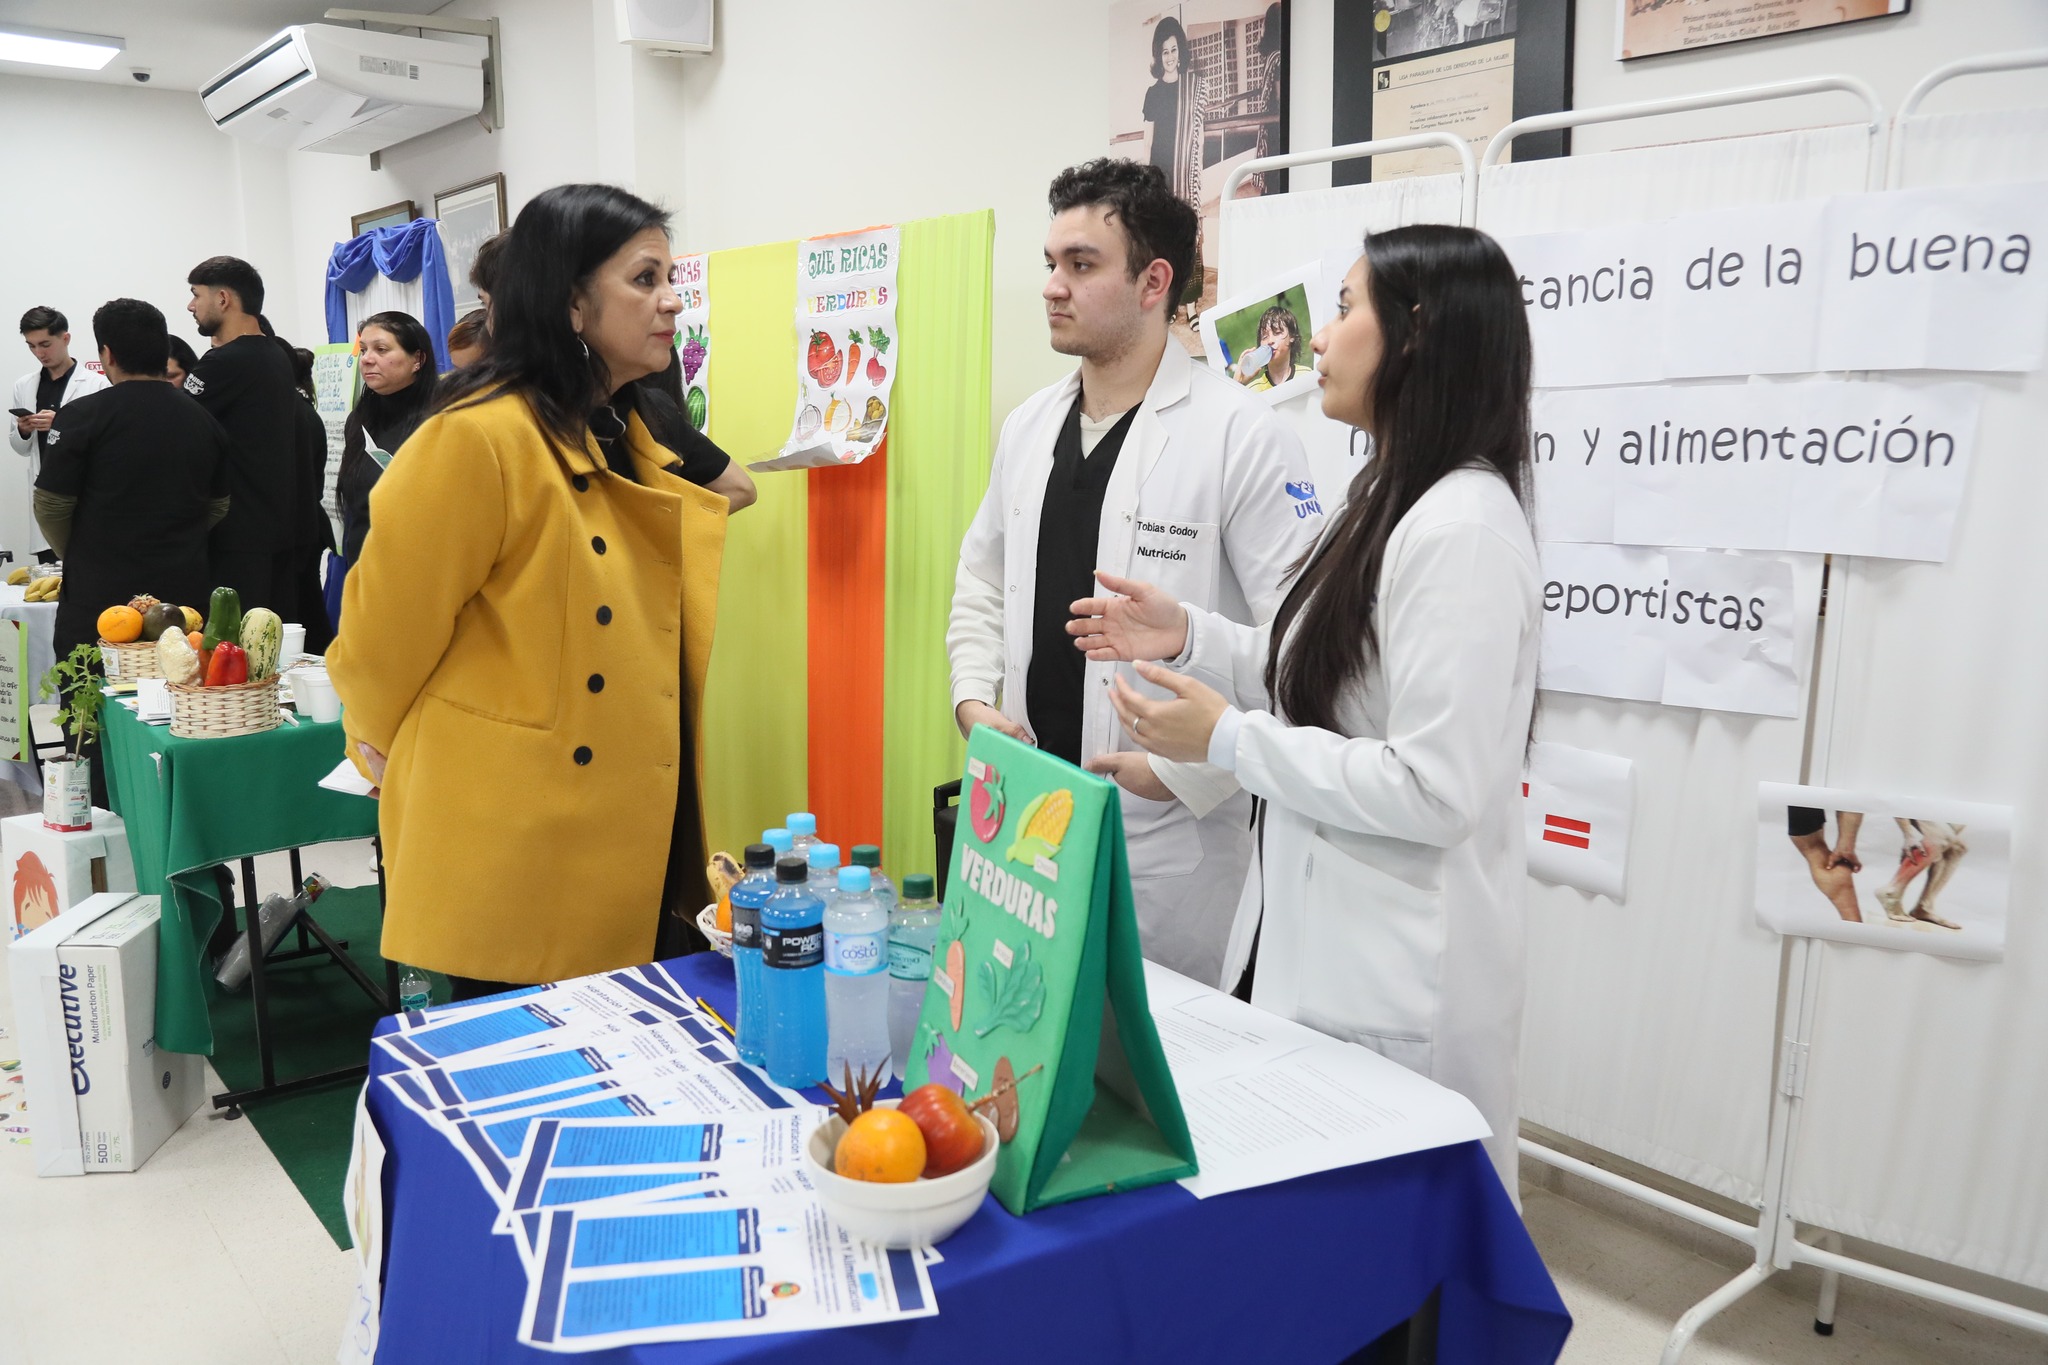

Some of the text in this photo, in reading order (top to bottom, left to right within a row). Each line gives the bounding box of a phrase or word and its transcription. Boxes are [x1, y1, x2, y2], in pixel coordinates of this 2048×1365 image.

[1453, 60, 1476, 70] DERECHOS
[808, 242, 888, 279] QUE RICAS
[1518, 231, 2032, 310] tancia de la buena
[806, 286, 888, 314] VERDURAS
[1583, 427, 1600, 466] y
[1620, 413, 1956, 468] alimentación
[1137, 521, 1199, 539] Tobias Godoy
[1137, 547, 1187, 561] Nutrición
[1543, 578, 1765, 632] eportistas
[960, 843, 1059, 939] VERDURAS
[842, 947, 878, 960] costa
[87, 964, 100, 1044] Multifunction Paper
[98, 1144, 108, 1163] 500
